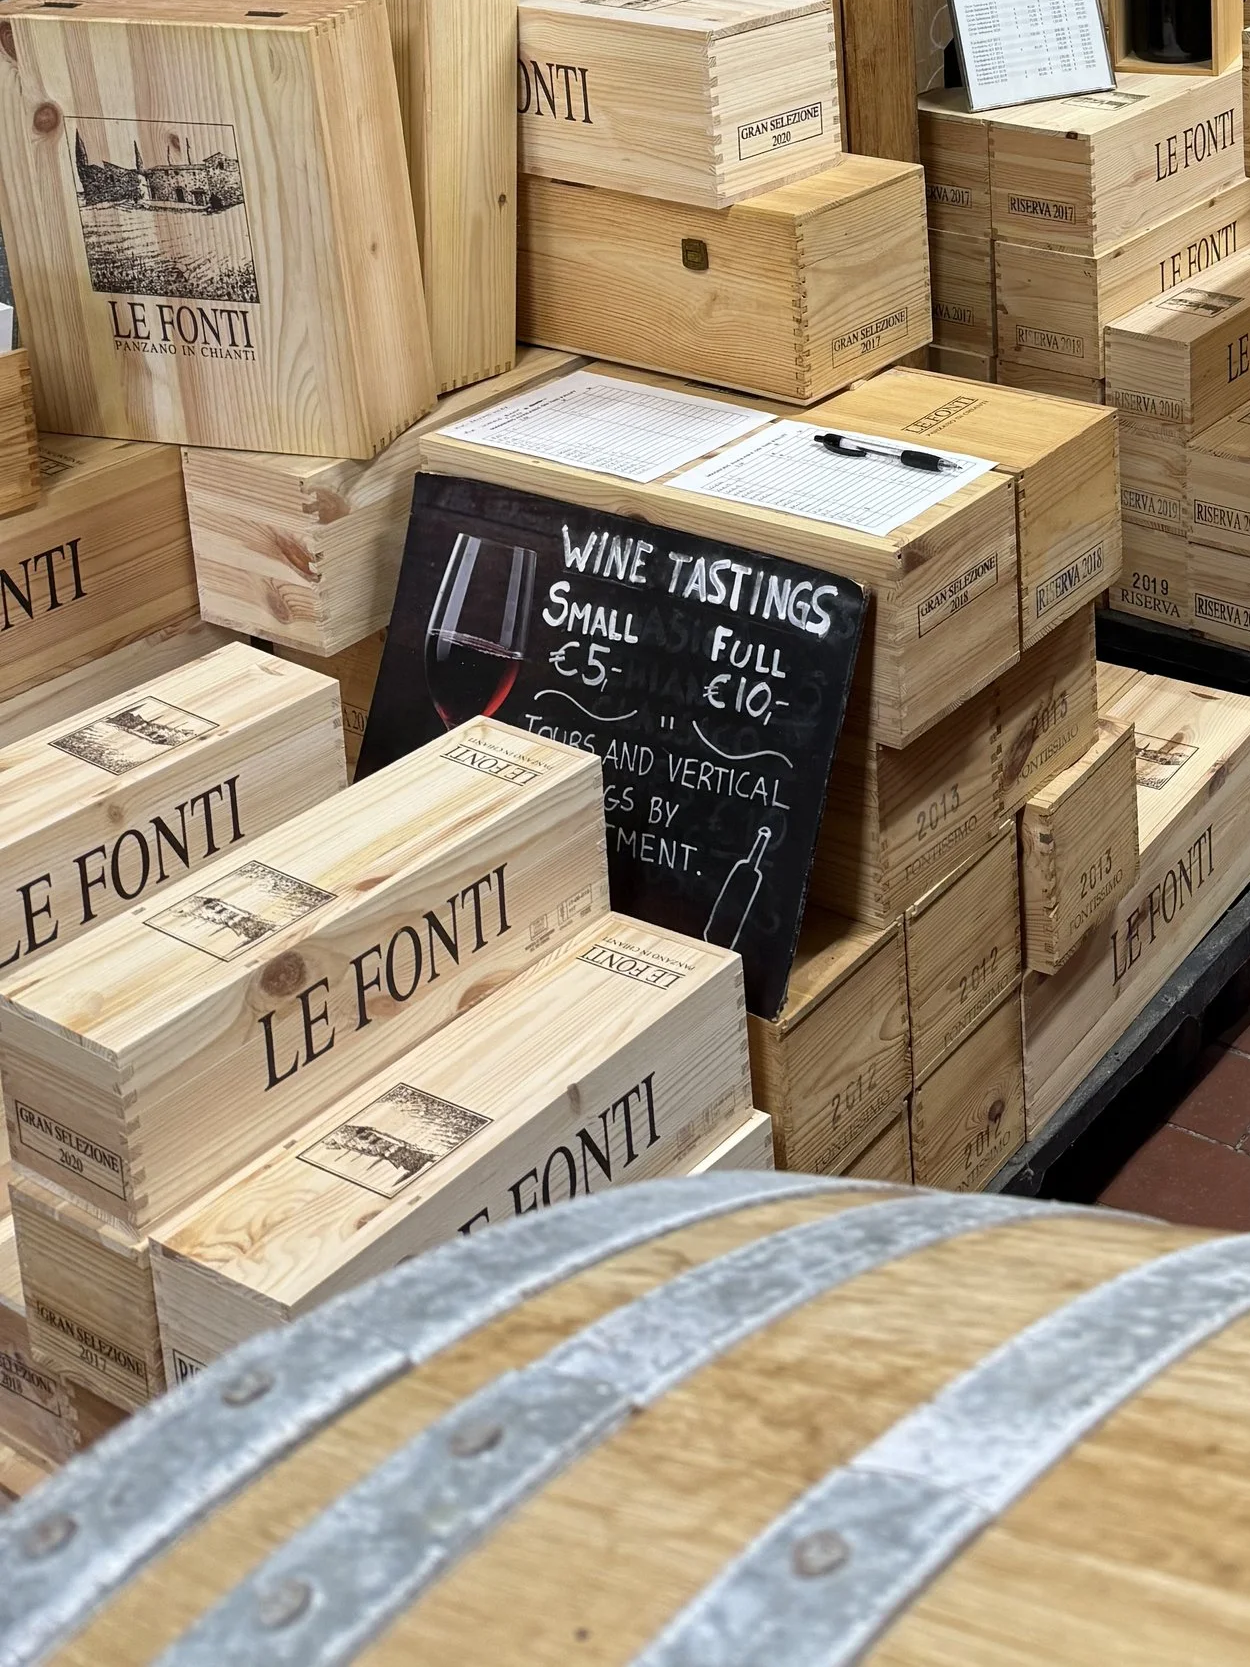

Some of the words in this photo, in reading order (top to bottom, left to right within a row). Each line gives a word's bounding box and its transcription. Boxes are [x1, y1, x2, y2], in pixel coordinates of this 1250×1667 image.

[740, 124, 768, 141] GRAN
[770, 105, 820, 133] SELEZIONE
[772, 131, 791, 147] 2020
[1153, 137, 1180, 183] LE
[1183, 108, 1236, 169] FONTI
[951, 189, 970, 206] 2017
[1010, 197, 1051, 217] RISERVA
[1053, 204, 1074, 223] 2017
[1160, 252, 1182, 293] LE
[1188, 221, 1237, 279] FONTI
[108, 301, 151, 340] LE
[157, 304, 255, 348] FONTI
[833, 335, 858, 354] GRAN
[860, 309, 907, 344] SELEZIONE
[952, 307, 972, 323] 2017
[114, 340, 177, 355] PANZANO
[182, 345, 196, 356] IN
[201, 346, 256, 361] CHIANTI
[860, 336, 881, 354] 2017
[1018, 327, 1059, 348] RISERVA
[1061, 336, 1082, 354] 2018
[1227, 333, 1249, 384] LE
[905, 421, 932, 434] LE
[925, 396, 976, 422] FONTI
[1114, 391, 1157, 415] RISERVA
[1159, 399, 1183, 420] 2019
[1157, 498, 1178, 518] 2019
[1196, 503, 1242, 531] RISERVA
[0, 537, 88, 631] NTI
[562, 524, 654, 586] WINE
[668, 551, 839, 639] TASTINGS
[921, 588, 947, 617] GRAN
[949, 556, 996, 599] SELEZIONE
[1038, 565, 1080, 611] RISERVA
[1082, 546, 1103, 579] 2018
[1132, 572, 1169, 596] 2019
[542, 580, 639, 644] SMALL
[950, 592, 969, 613] 2018
[1121, 589, 1180, 618] RISERVA
[1197, 596, 1242, 624] RISERVA
[711, 626, 787, 679] FULL
[444, 746, 511, 774] FONTI
[505, 767, 539, 784] LE
[602, 738, 654, 777] AND
[667, 759, 792, 811] VERTICAL
[648, 796, 680, 828] BY
[915, 783, 960, 842] 2013
[73, 774, 245, 926] FONTI
[905, 814, 978, 881] FONTISSIMO
[1080, 846, 1113, 900] 2013
[1110, 908, 1142, 986] LE
[1145, 825, 1216, 942] FONTI
[580, 946, 650, 977] FONTI
[602, 936, 640, 952] CHIANTI
[653, 953, 696, 971] PANZANO
[258, 977, 337, 1092] LE
[348, 862, 512, 1032] FONTI
[646, 969, 681, 988] LE
[959, 945, 998, 1004] 2012
[19, 1106, 53, 1138] GRAN
[54, 1124, 120, 1174] SELEZIONE
[507, 1071, 661, 1216] FONTI
[59, 1147, 84, 1174] 2020
[40, 1306, 75, 1338] GRAN
[77, 1326, 145, 1378] SELEZIONE
